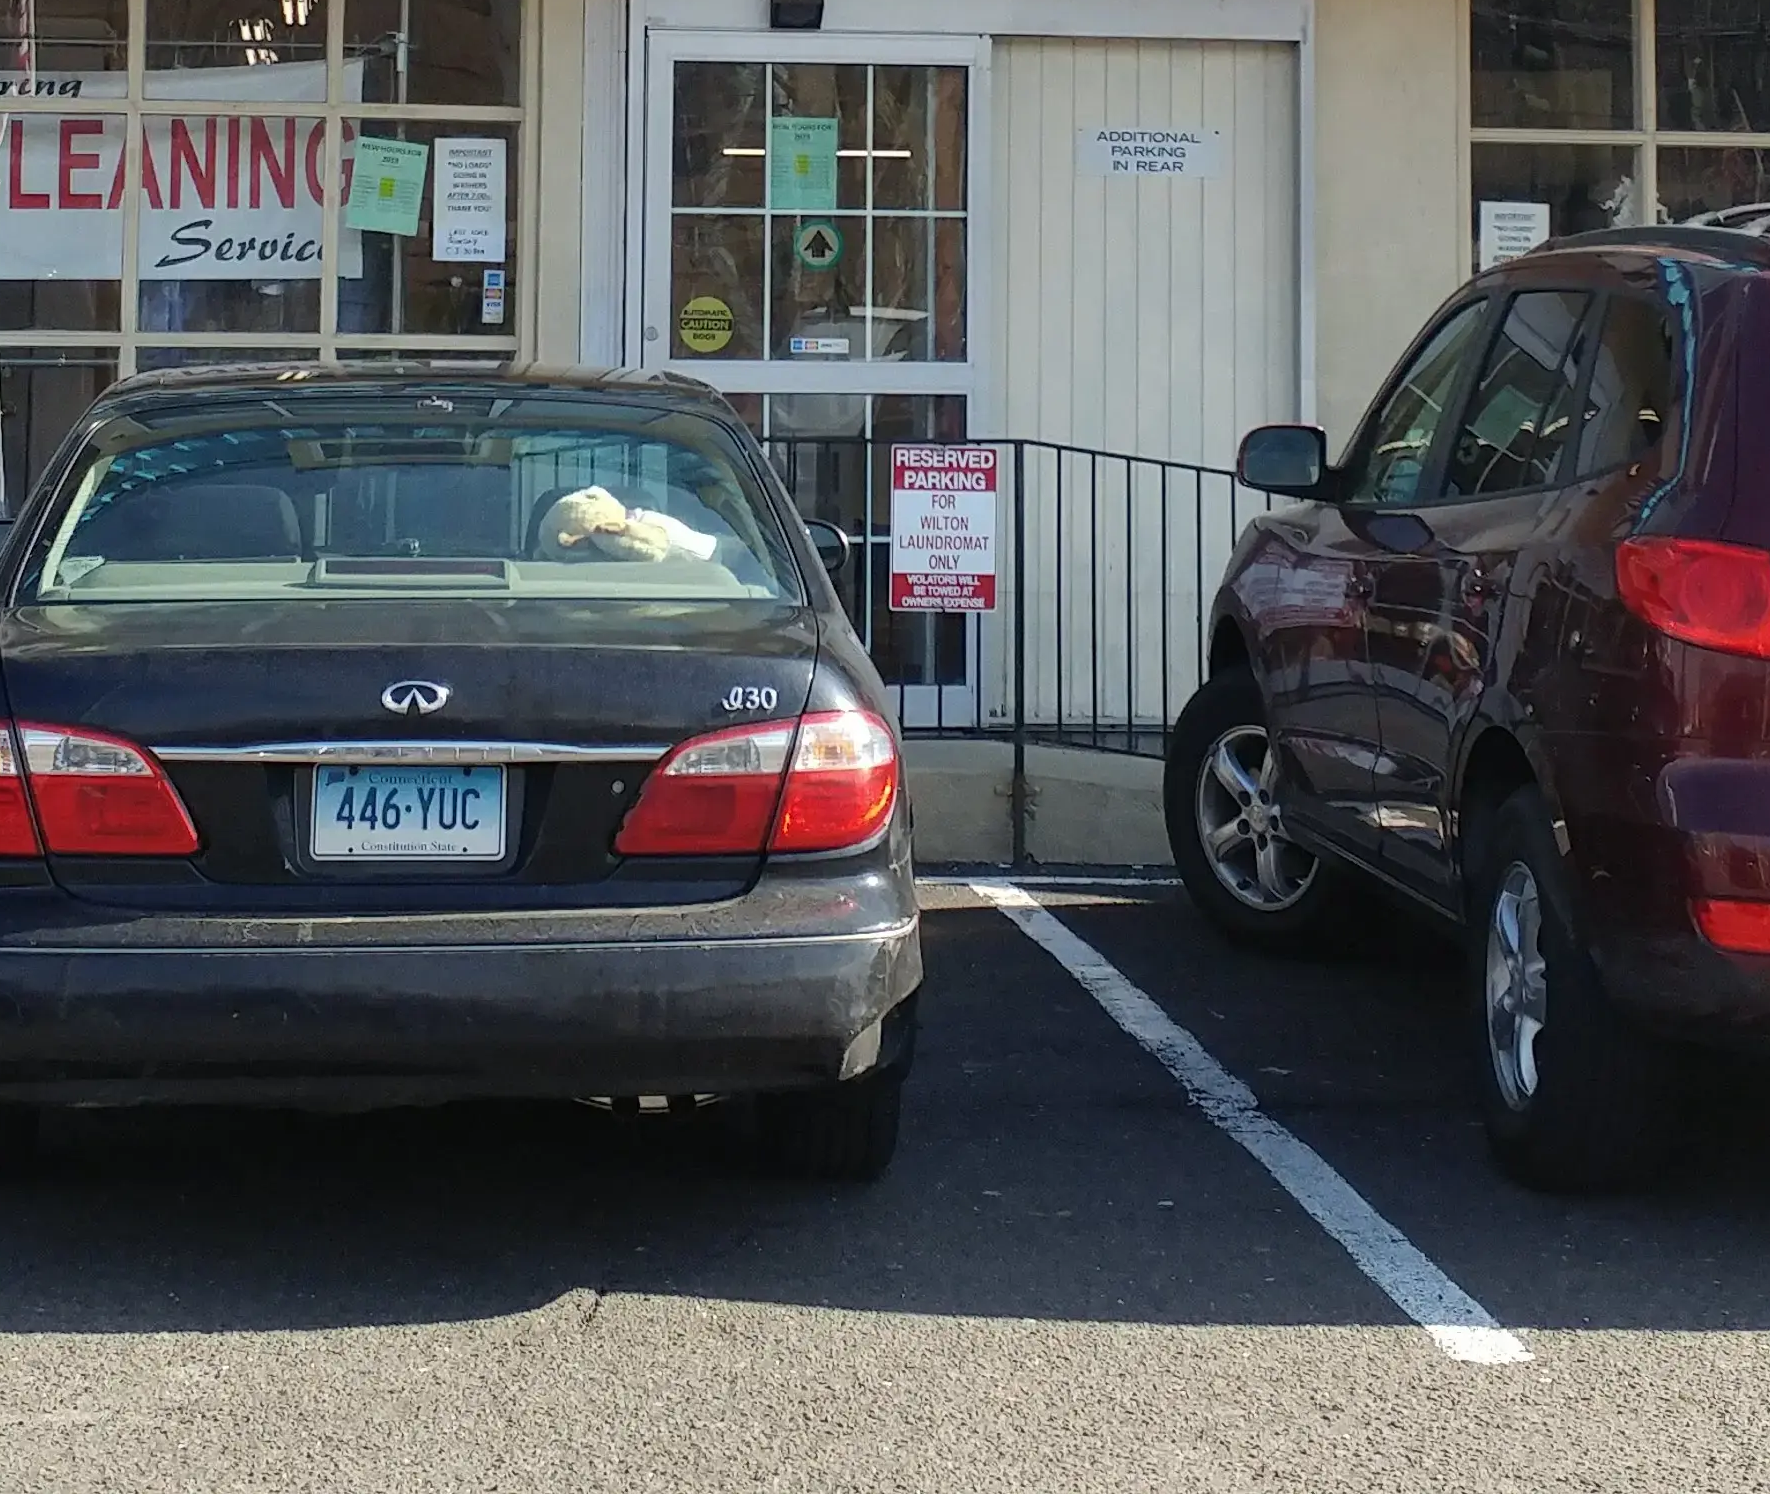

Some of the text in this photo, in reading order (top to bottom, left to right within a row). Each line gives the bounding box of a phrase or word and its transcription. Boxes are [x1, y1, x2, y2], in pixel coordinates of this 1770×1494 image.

[1096, 130, 1202, 144] ADDITIONAL
[1111, 146, 1187, 159] PARKING
[1113, 160, 1185, 172] IN REAR
[153, 218, 324, 268] Servic
[680, 319, 730, 330] CAUTION
[895, 449, 995, 469] RESERVED
[904, 471, 987, 490] PARKING
[931, 494, 956, 510] FOR
[920, 516, 969, 531] WILTON
[899, 535, 989, 551] LAUNDROMAT
[928, 554, 961, 570] ONLY
[906, 574, 981, 586] VIOLATORS WILL
[913, 586, 975, 597] BE TOWED AT
[943, 598, 985, 608] EXPENSE
[368, 773, 453, 786] Connecticut
[360, 841, 457, 852] Constitution State
